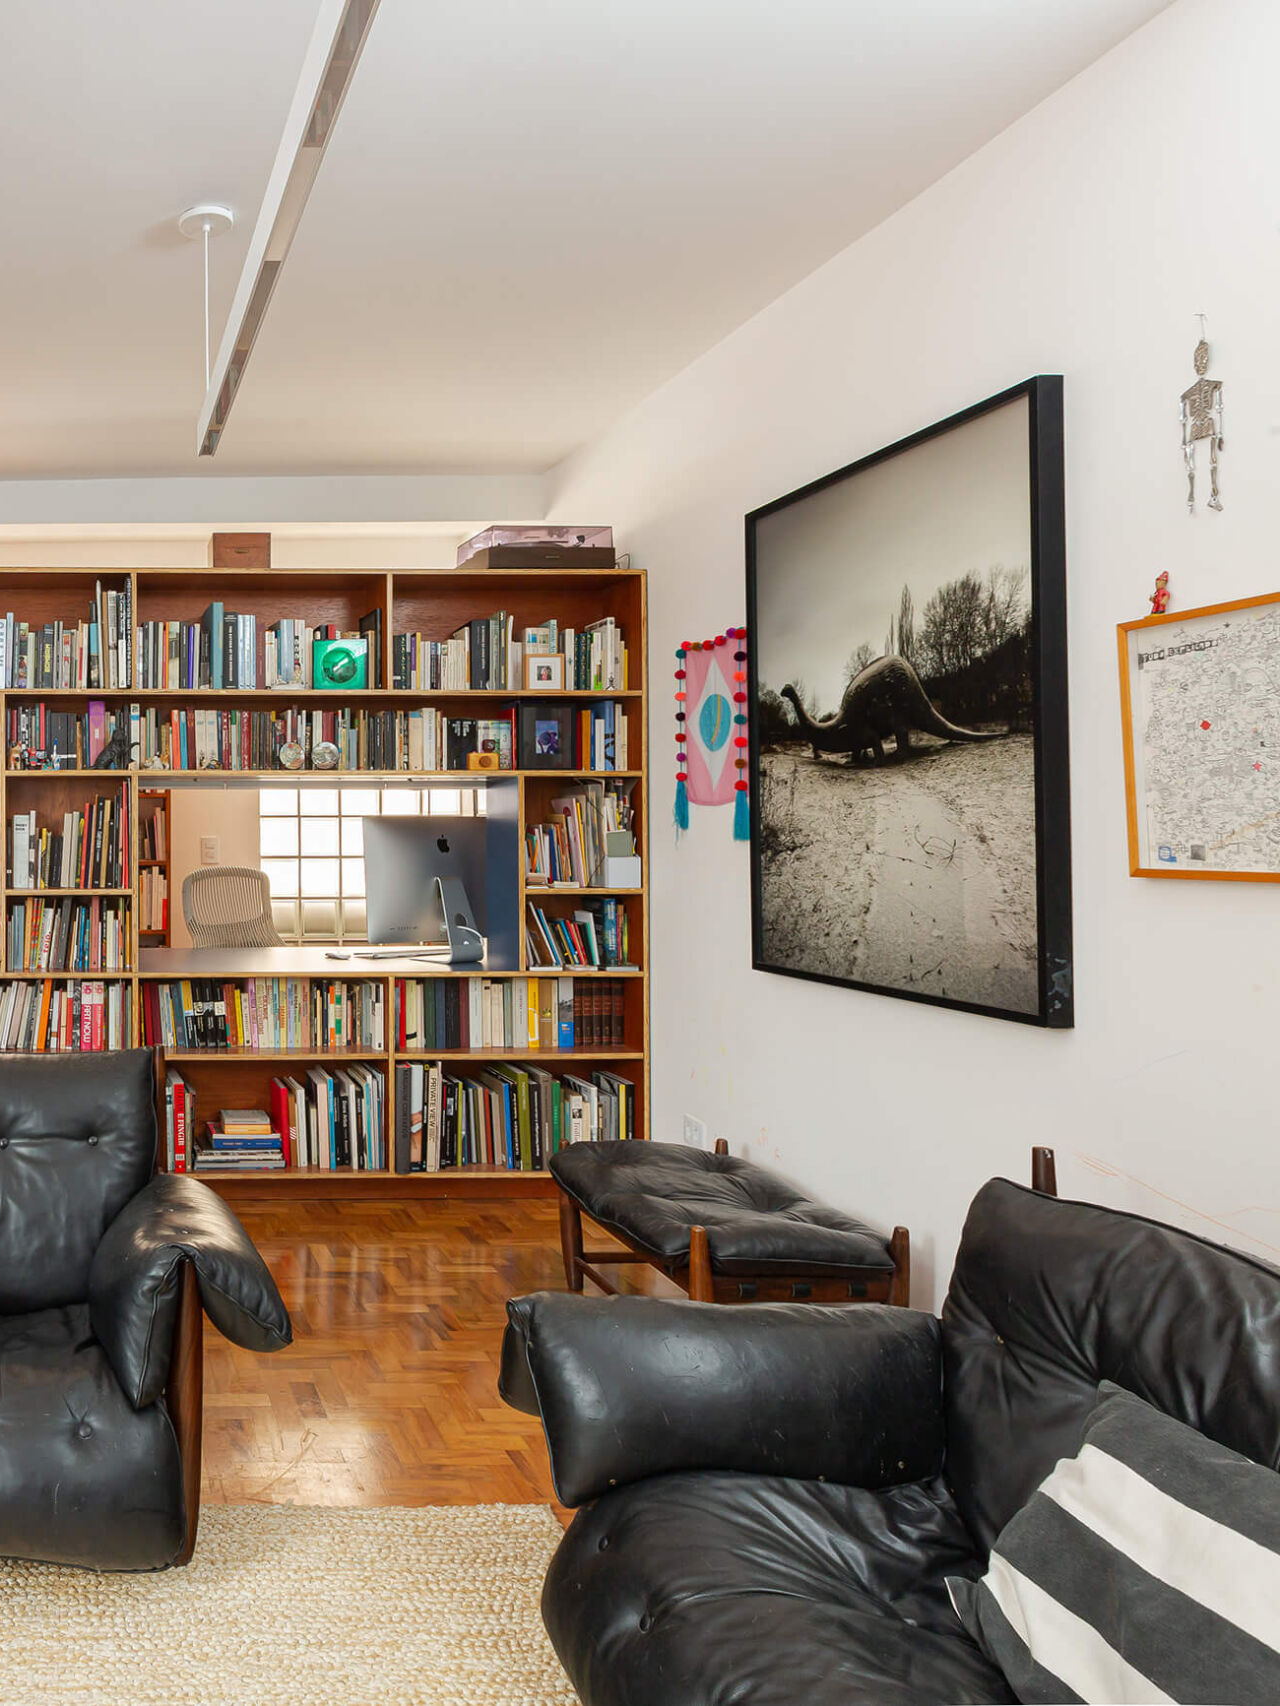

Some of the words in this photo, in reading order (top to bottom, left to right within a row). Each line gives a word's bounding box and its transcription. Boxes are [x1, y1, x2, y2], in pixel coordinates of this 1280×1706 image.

[83, 1005, 91, 1022] ART
[83, 1022, 91, 1043] NOW
[429, 1077, 437, 1105] PRIVATE
[177, 1119, 185, 1146] FINGIR
